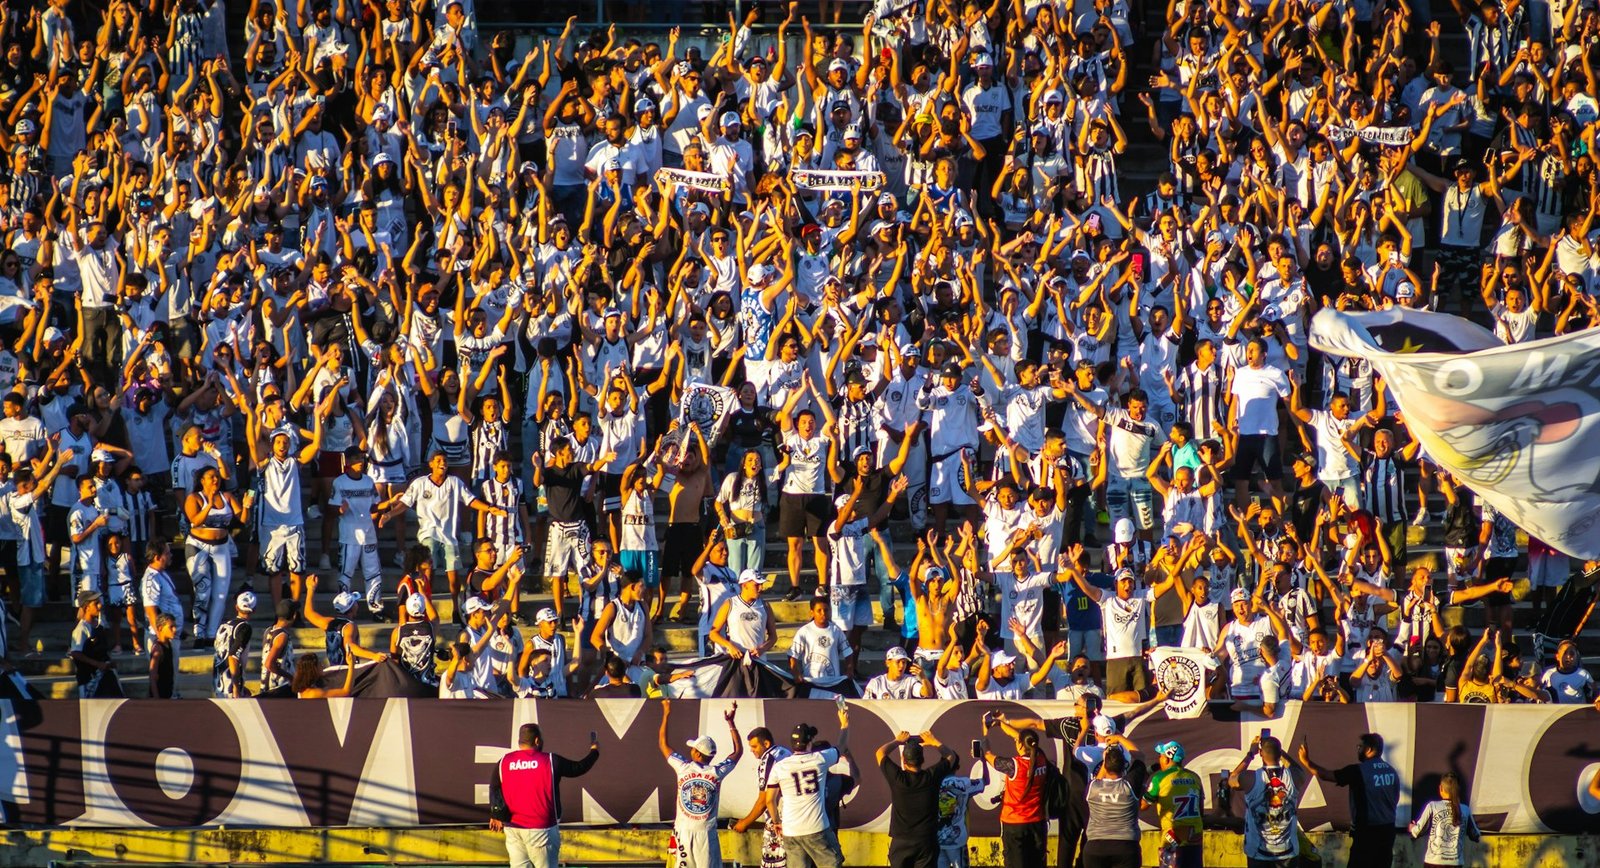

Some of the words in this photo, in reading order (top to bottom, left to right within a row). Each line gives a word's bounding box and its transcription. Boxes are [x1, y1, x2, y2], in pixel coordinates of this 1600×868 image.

[808, 173, 835, 187] BELA
[1124, 421, 1133, 431] 13
[1077, 596, 1089, 611] 10
[509, 759, 538, 771] RÁDIO
[791, 769, 821, 797] 13
[1373, 774, 1395, 787] 2107
[1098, 793, 1120, 803] TV
[1172, 794, 1200, 820] ZL
